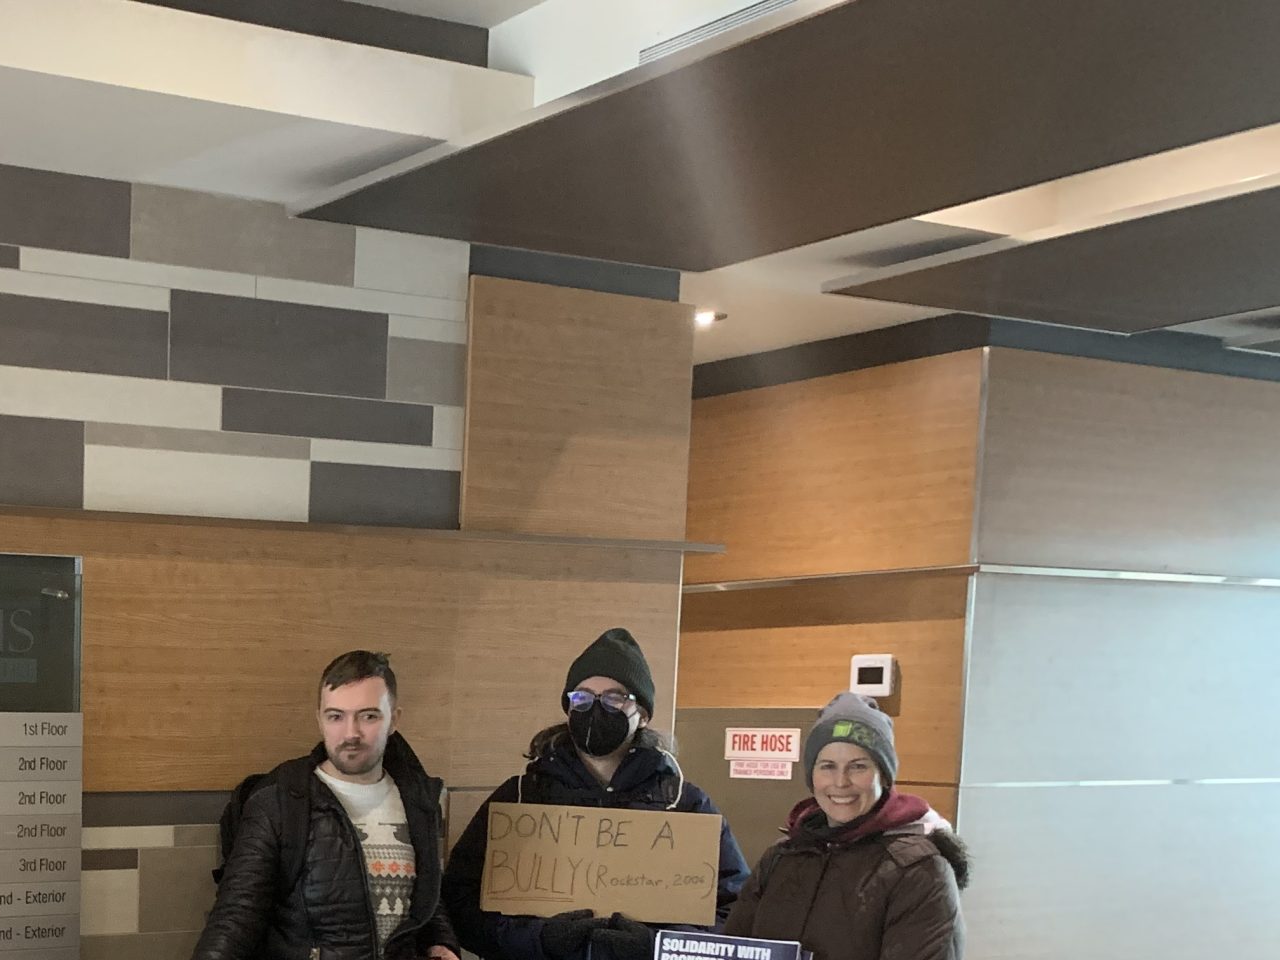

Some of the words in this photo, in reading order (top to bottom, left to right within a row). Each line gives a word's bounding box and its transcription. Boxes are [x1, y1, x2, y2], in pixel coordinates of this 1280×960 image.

[22, 722, 38, 736] 1st
[41, 722, 68, 736] Floor
[732, 733, 757, 751] FIRE
[761, 734, 793, 752] HOSE
[18, 757, 36, 771] 2nd
[39, 757, 67, 771] Floor
[18, 791, 36, 805] 2nd
[39, 791, 66, 805] Floor
[17, 824, 37, 838] 2nd
[40, 823, 67, 838] Floor
[490, 811, 585, 845] DON'T
[596, 818, 632, 848] BE
[651, 820, 674, 850] A
[18, 858, 37, 872] 3rd
[39, 858, 67, 872] Floor
[487, 850, 583, 896] BULLY
[25, 890, 66, 904] Exterior
[24, 925, 66, 939] Exterior
[662, 938, 735, 957] SOLIDARITY
[737, 945, 771, 960] WITH
